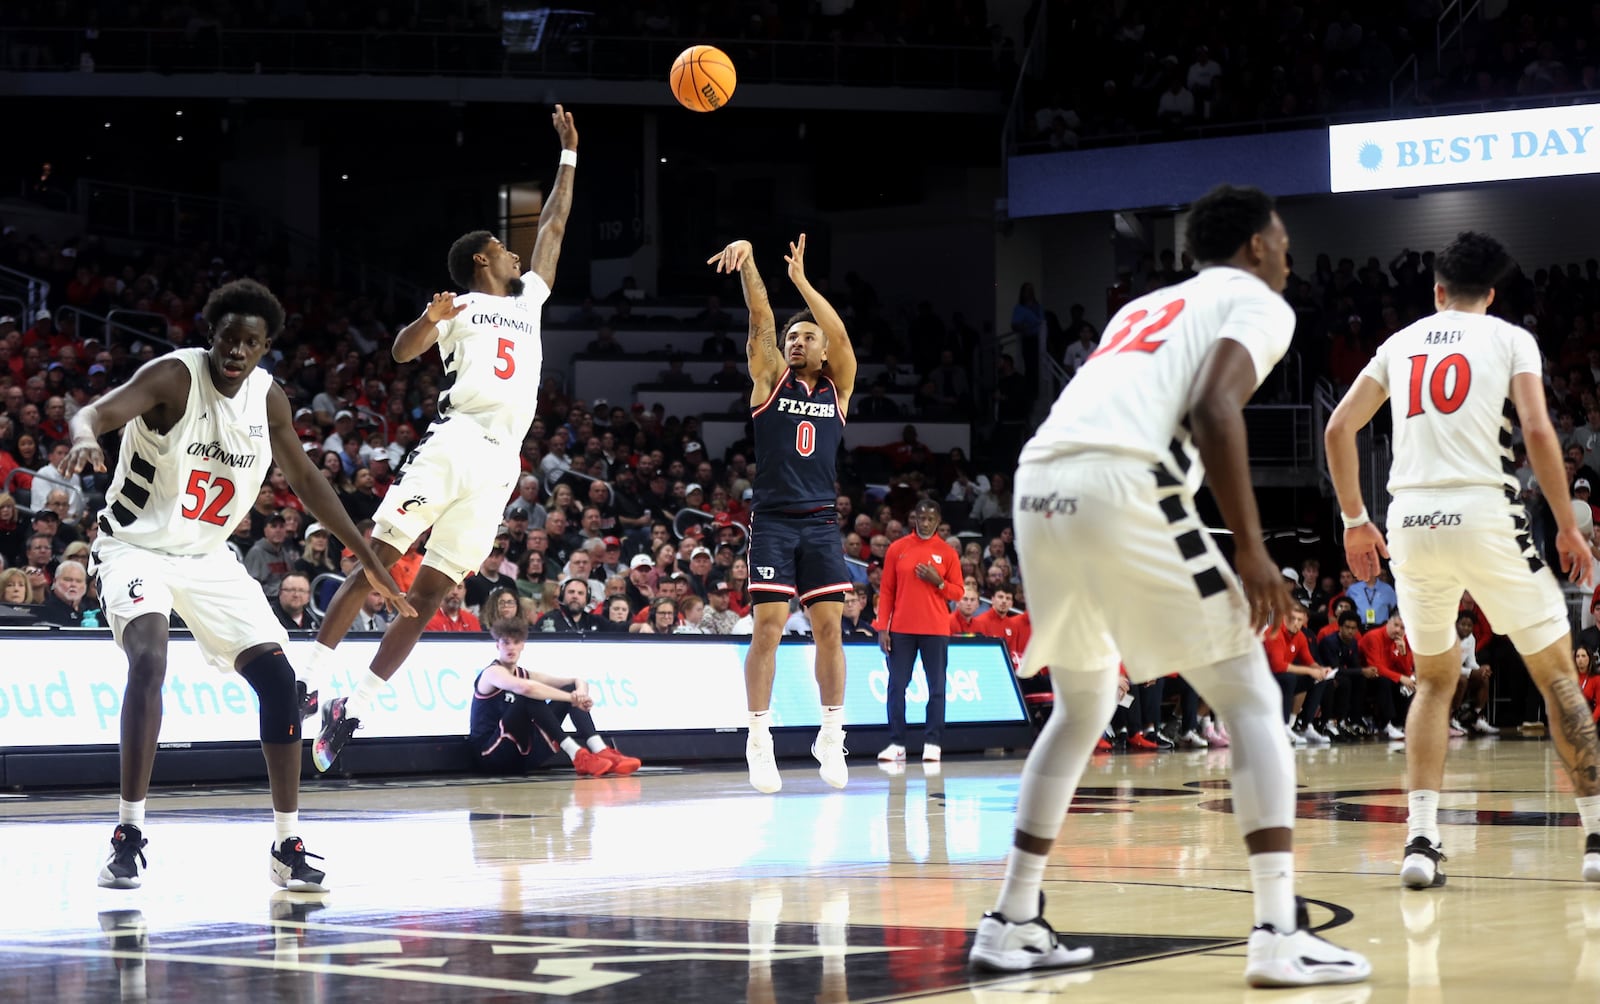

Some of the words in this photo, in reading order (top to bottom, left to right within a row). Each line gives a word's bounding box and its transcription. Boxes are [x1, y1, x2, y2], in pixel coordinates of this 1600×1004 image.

[1396, 133, 1498, 168] BEST
[1511, 125, 1594, 159] DAY
[472, 313, 533, 335] CINCINNATI
[1424, 330, 1465, 345] ABAEV
[493, 337, 515, 380] 5
[1406, 352, 1472, 419] 10
[777, 397, 836, 418] FLYERS
[187, 441, 256, 468] CINCINNATI
[795, 420, 816, 457] 0
[181, 469, 235, 527] 52
[1402, 512, 1463, 529] BEARCATS
[407, 668, 467, 712] UC
